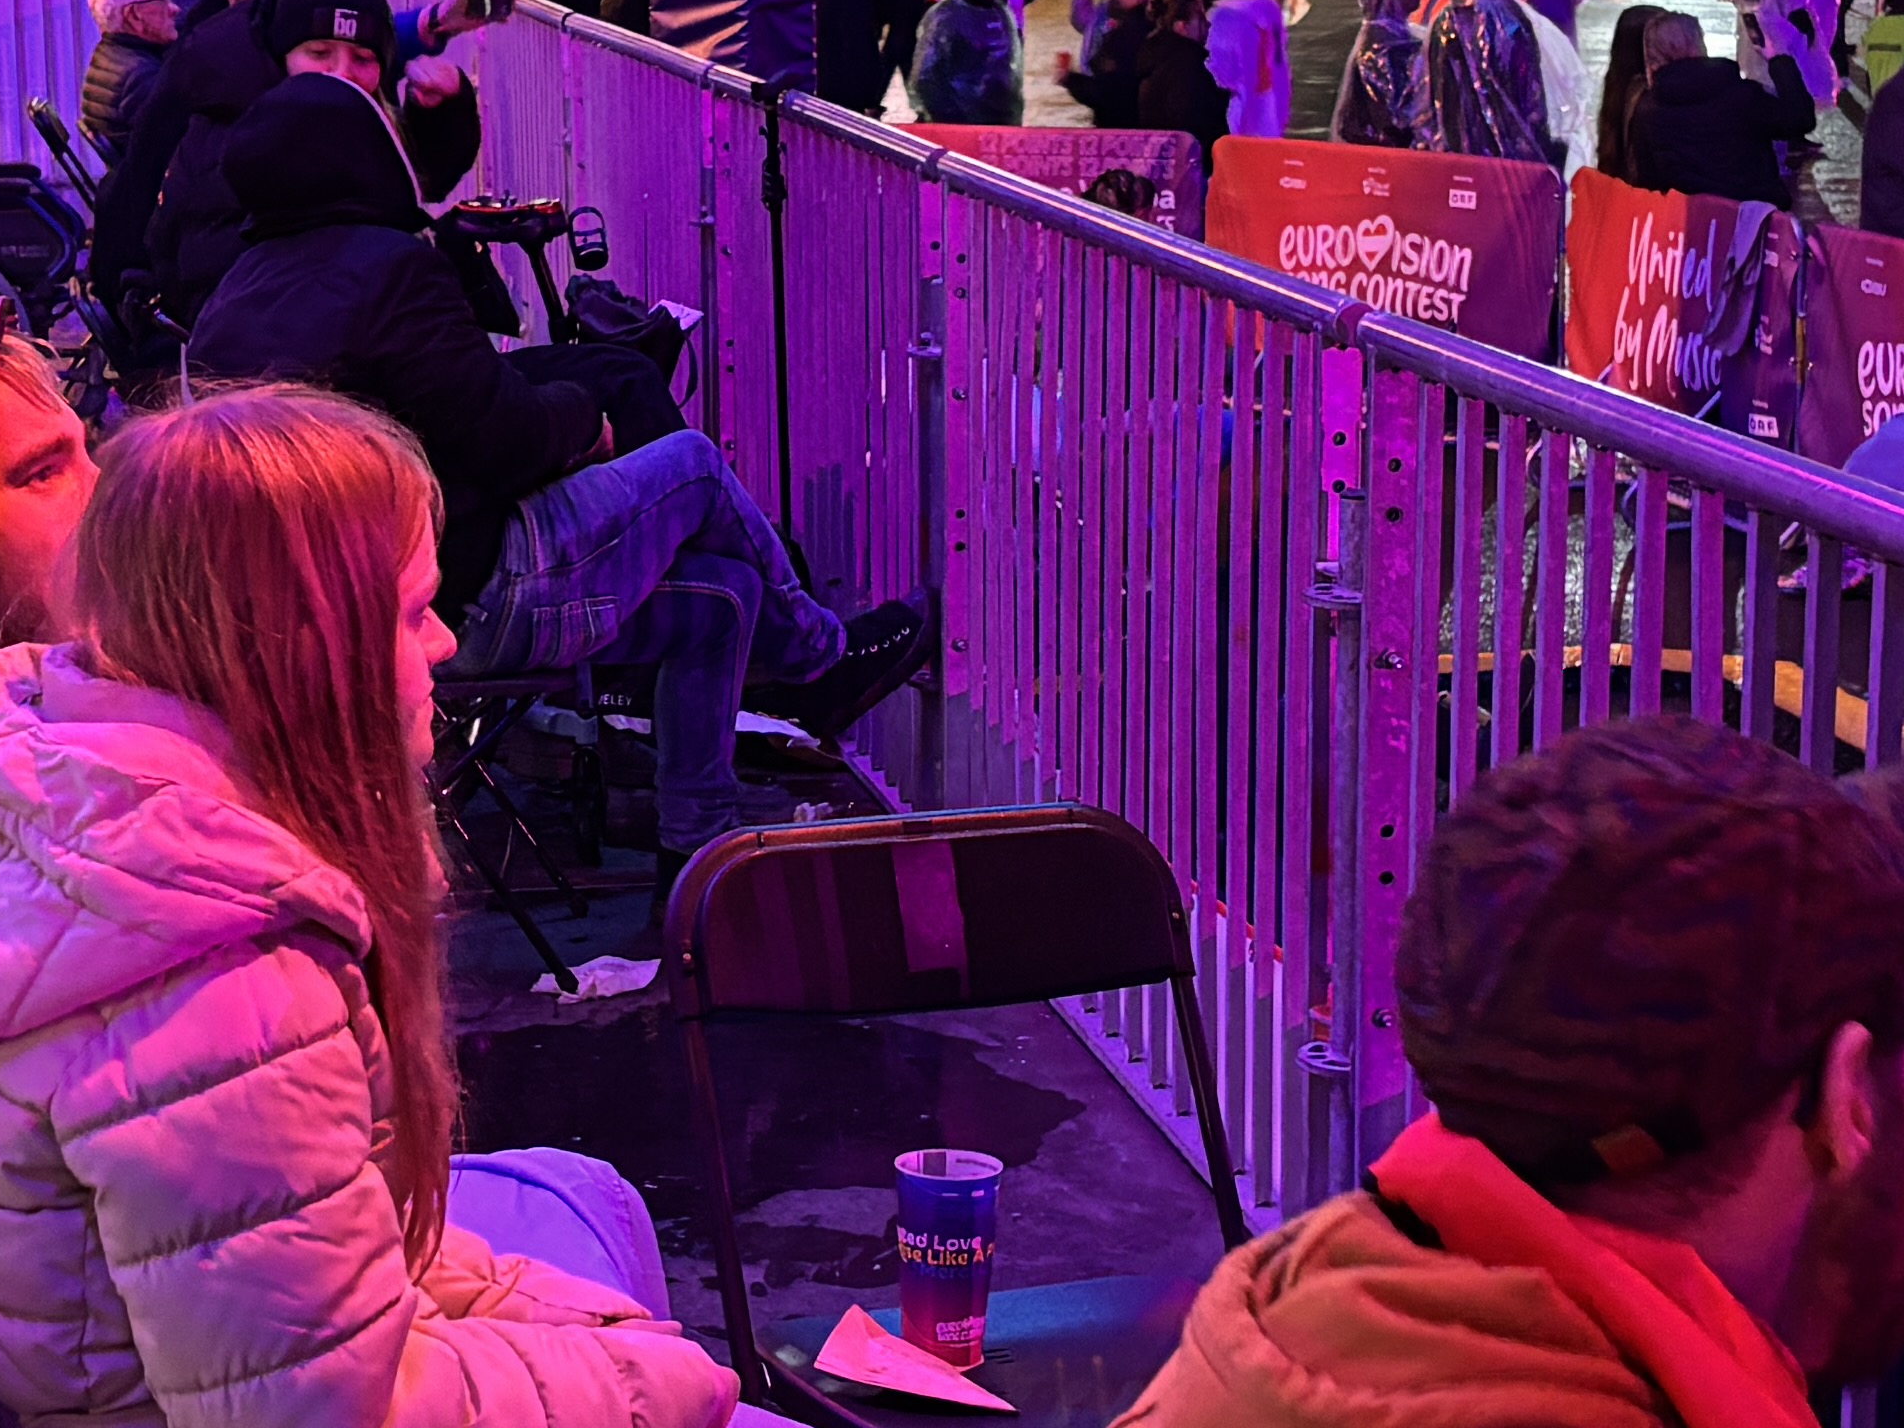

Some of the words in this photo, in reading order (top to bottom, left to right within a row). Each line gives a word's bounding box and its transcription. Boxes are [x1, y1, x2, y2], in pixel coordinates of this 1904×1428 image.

[1349, 272, 1466, 324] CONTEST
[1628, 211, 1718, 313] United
[1613, 286, 1643, 391] by
[1645, 304, 1724, 399] Music
